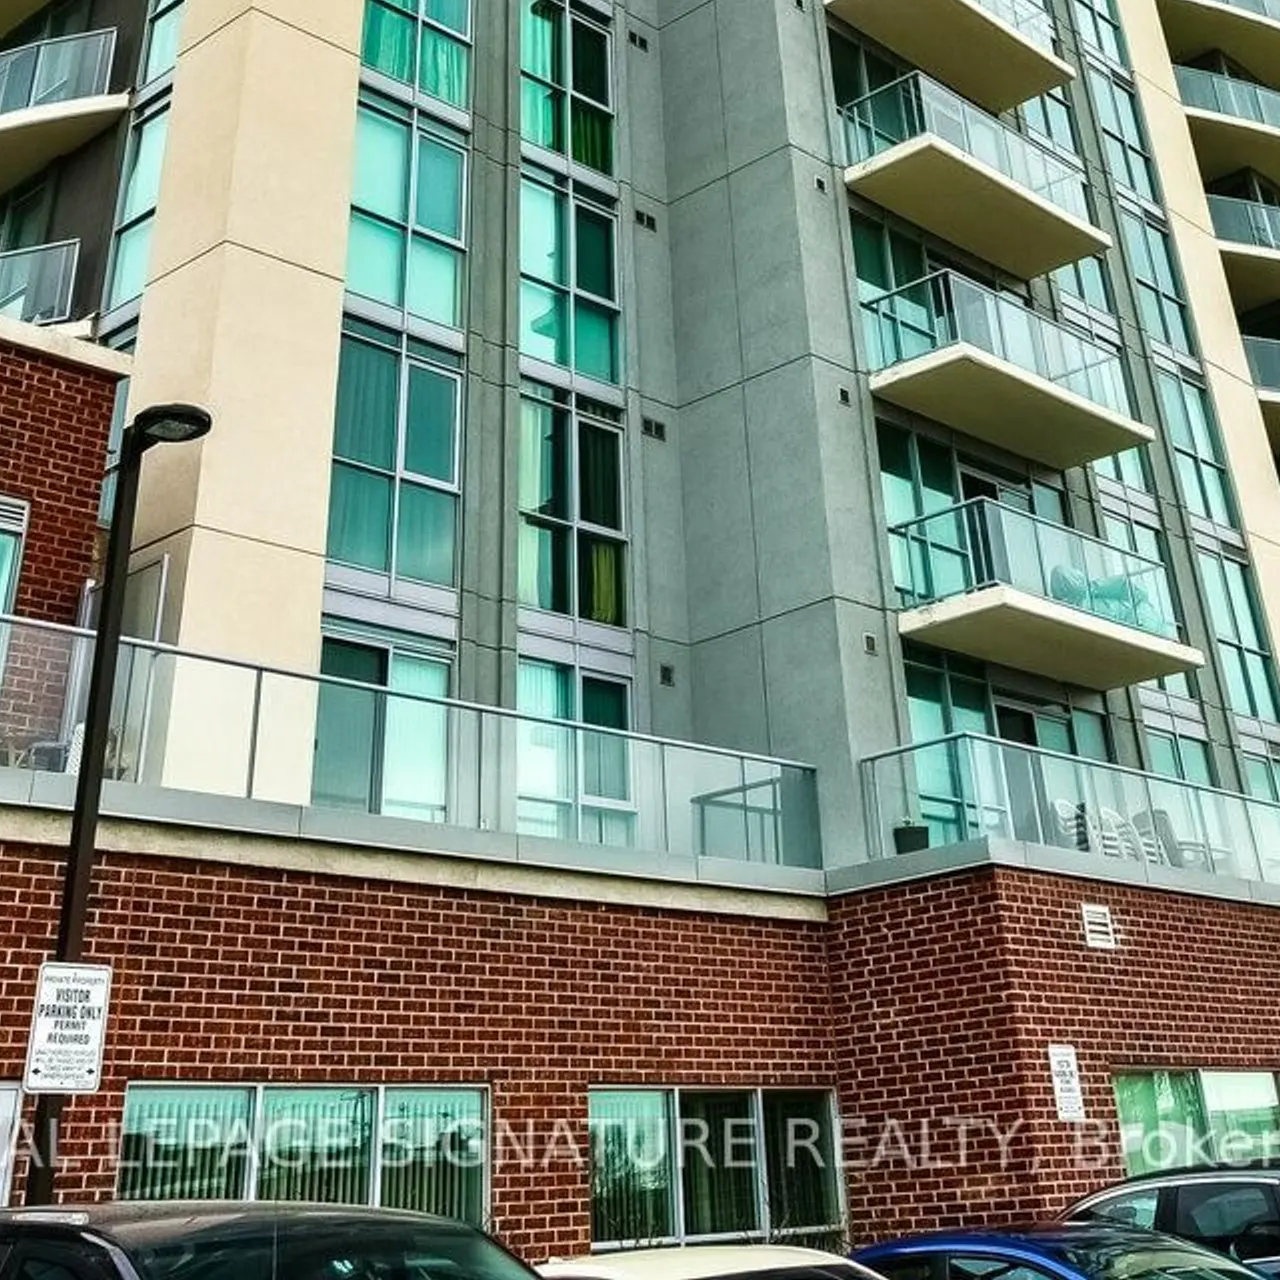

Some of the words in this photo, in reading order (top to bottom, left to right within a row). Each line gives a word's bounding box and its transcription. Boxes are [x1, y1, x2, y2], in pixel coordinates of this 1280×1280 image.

[56, 988, 91, 1003] VISITOR
[39, 1004, 78, 1019] PARKING
[80, 1006, 103, 1020] ONLY
[54, 1020, 87, 1031] PERMIT
[46, 1032, 91, 1045] REQUIRED
